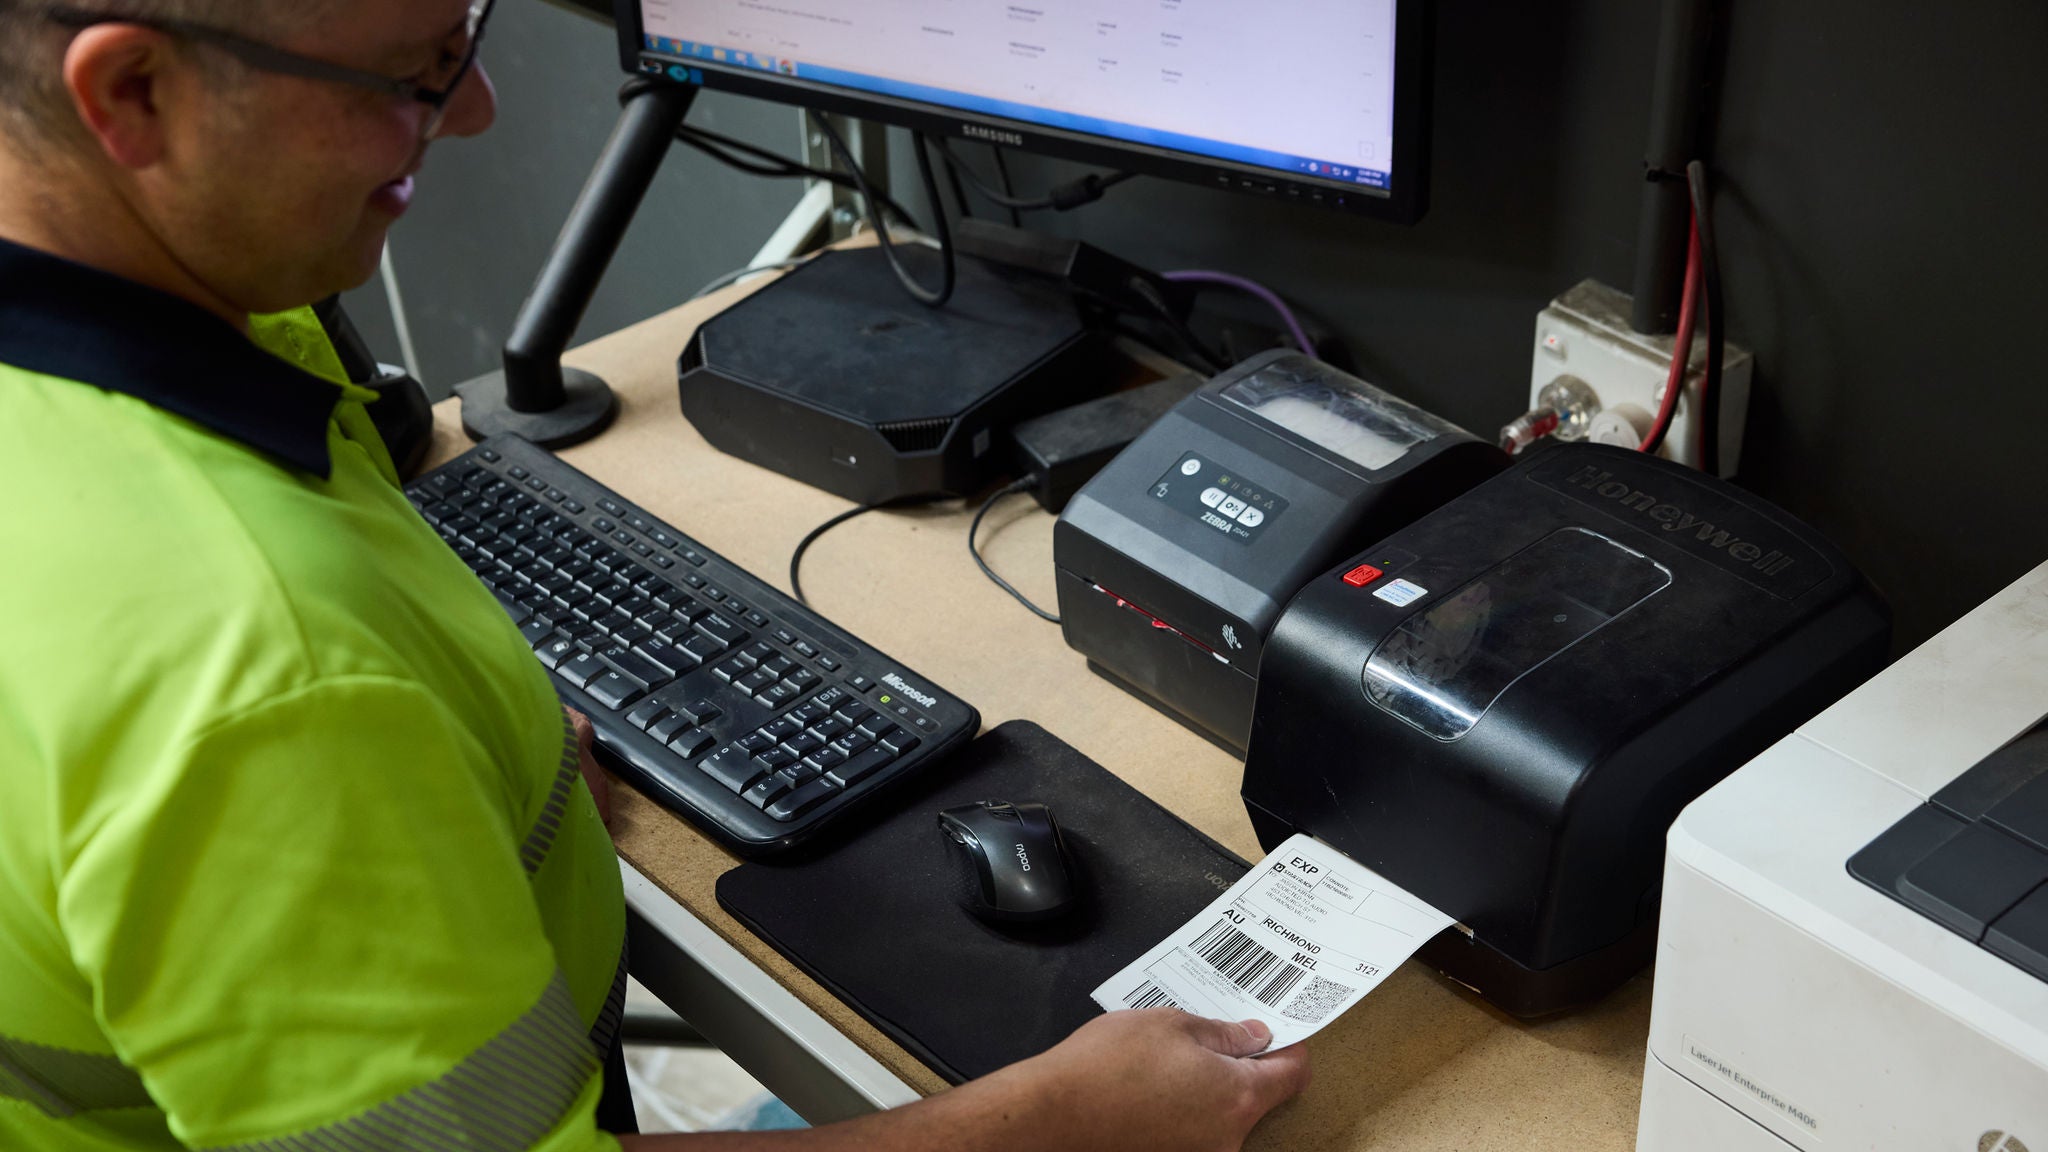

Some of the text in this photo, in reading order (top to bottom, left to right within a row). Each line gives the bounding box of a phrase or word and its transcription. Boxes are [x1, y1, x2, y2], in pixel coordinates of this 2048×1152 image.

[962, 124, 1023, 146] SAMSUNG
[1200, 512, 1233, 534] ZEBRA
[1566, 465, 1795, 576] Honeywell
[882, 671, 937, 709] Microsoft
[1284, 870, 1312, 888] STARTRACK
[1290, 856, 1319, 876] EXP
[1265, 891, 1294, 910] RICHMOND
[1275, 882, 1302, 900] ADDICTED
[1310, 904, 1328, 914] AUDIO
[1280, 893, 1303, 908] CHURCH
[1222, 908, 1246, 926] AU
[1291, 952, 1318, 972] MEL
[1263, 917, 1379, 977] RICHMOND 3121
[1691, 1045, 1817, 1129] LaserJet Enterprise M406
